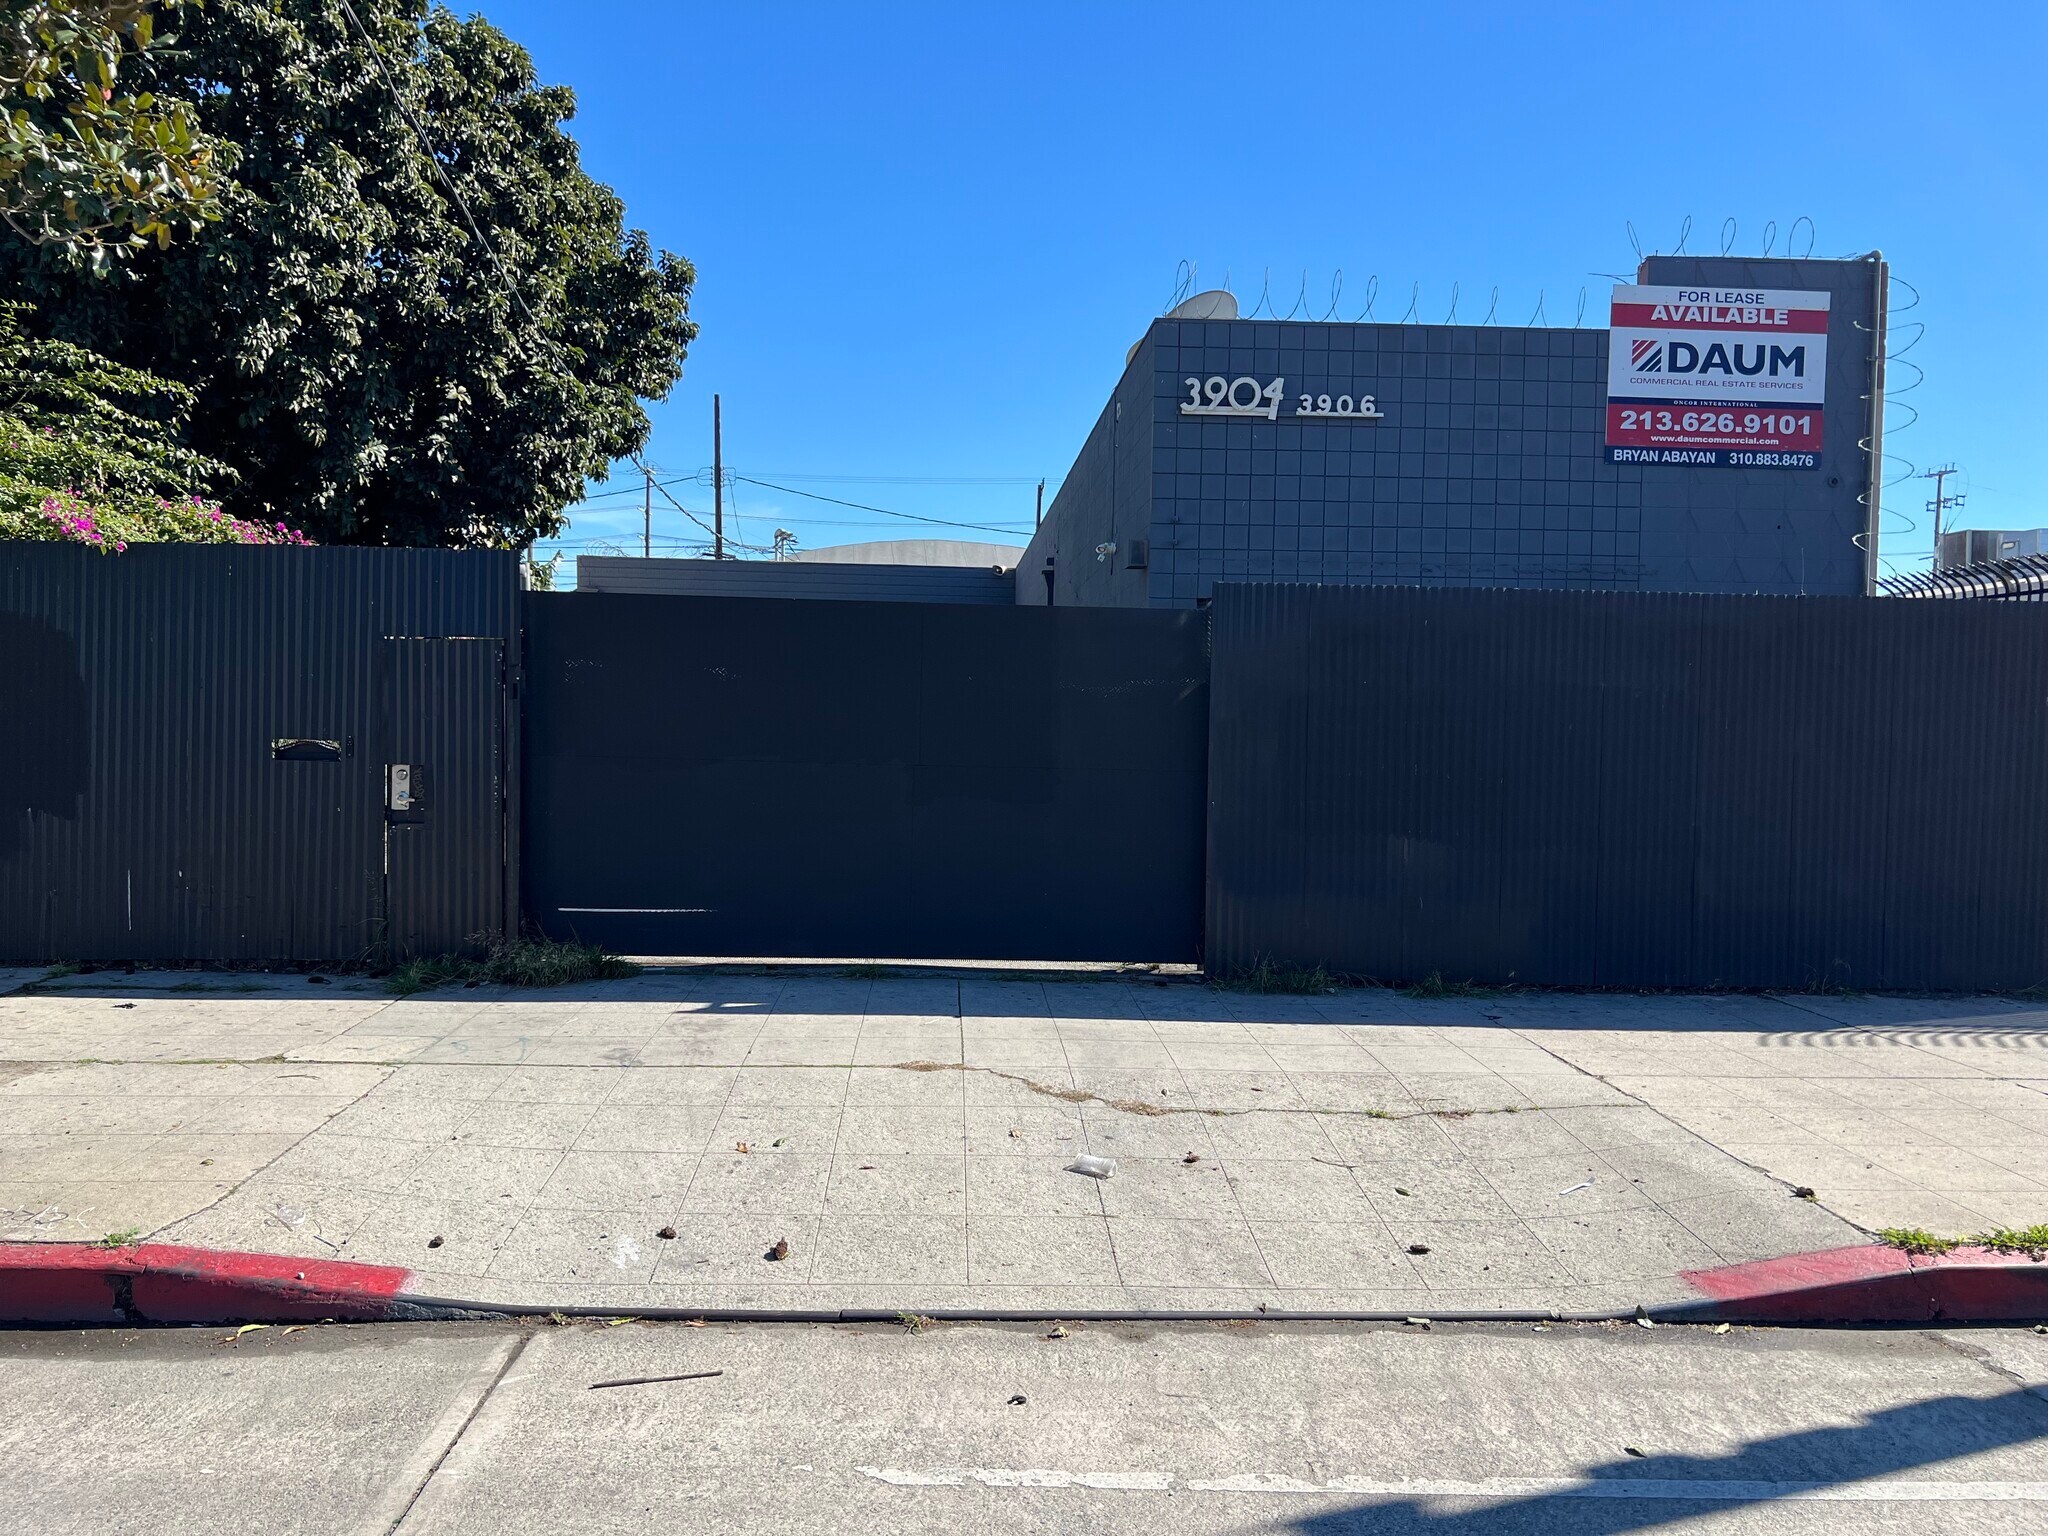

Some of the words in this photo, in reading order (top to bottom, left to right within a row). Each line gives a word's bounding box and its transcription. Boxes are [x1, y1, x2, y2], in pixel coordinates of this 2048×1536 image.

[1679, 291, 1709, 302] FOR
[1715, 292, 1764, 304] LEASE
[1651, 305, 1788, 325] AVAILABLE
[1668, 342, 1805, 377] DAUM
[1630, 377, 1693, 386] COMMERCIAL
[1696, 379, 1719, 387] REAL
[1722, 380, 1756, 388] ESTATE
[1180, 376, 1284, 420] 3904
[1296, 394, 1376, 416] 3906
[1620, 411, 1811, 435] 213.626.9101
[1651, 435, 1779, 445] www.daumcommercial.com
[1614, 450, 1658, 462] BRYAN
[1662, 451, 1715, 464] ABAYAN
[1730, 453, 1813, 466] 310.883.8476
